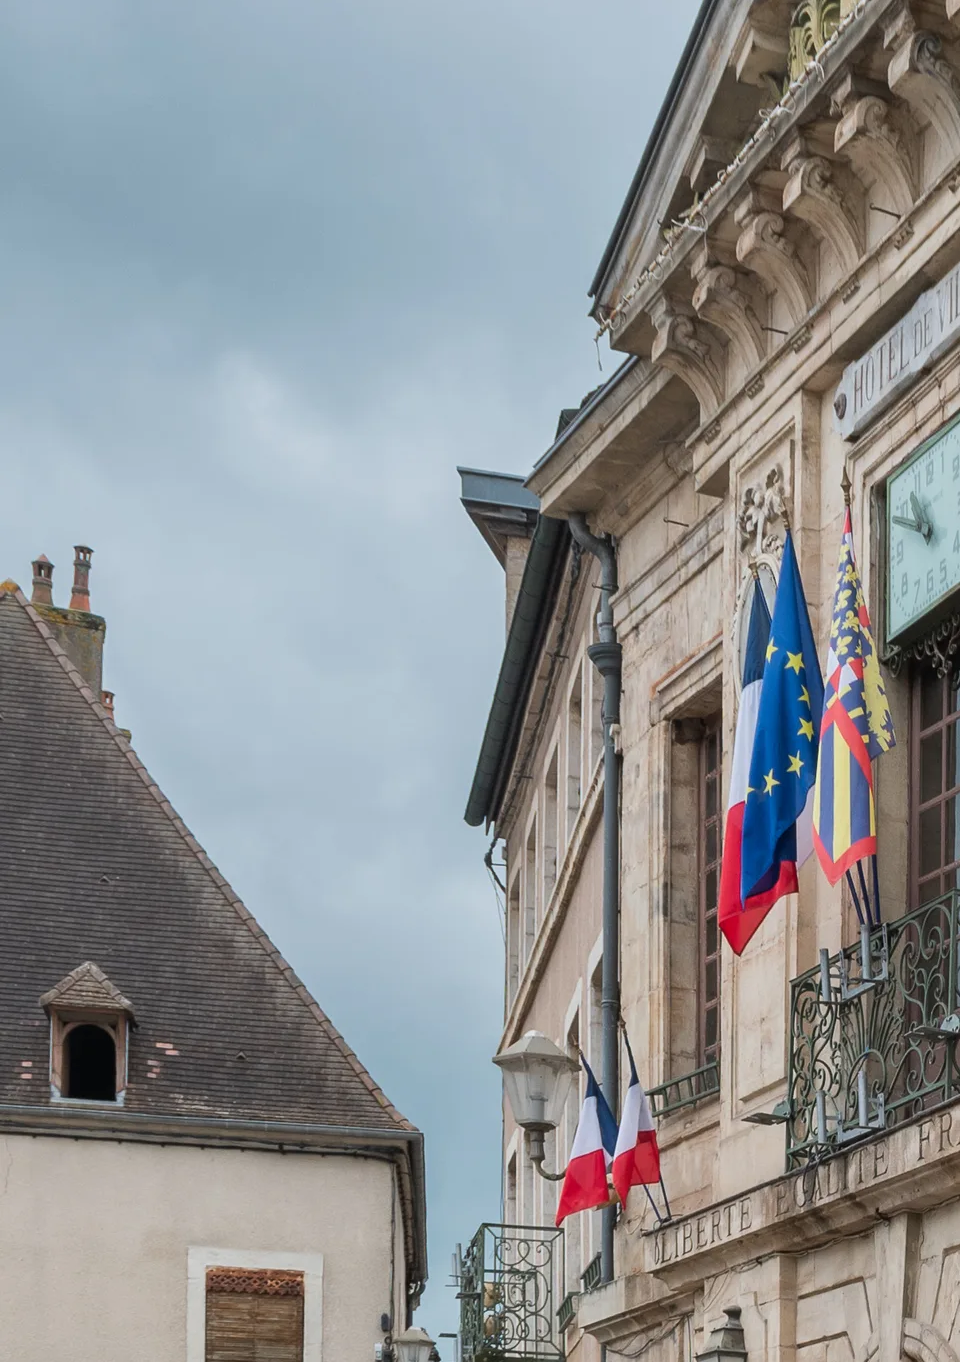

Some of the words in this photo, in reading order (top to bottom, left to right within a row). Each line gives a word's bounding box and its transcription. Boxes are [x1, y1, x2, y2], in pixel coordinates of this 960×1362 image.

[854, 326, 910, 414] HÔTEL
[914, 308, 933, 358] DE
[926, 459, 934, 487] 12
[940, 451, 944, 475] 1
[952, 455, 960, 481] 2
[914, 470, 921, 495] 11
[896, 539, 904, 566] 9
[953, 530, 960, 554] 4
[926, 567, 934, 594] 6
[940, 558, 947, 583] 5
[901, 572, 908, 597] 8
[914, 577, 921, 604] 7
[660, 1196, 753, 1264] LIBERTE
